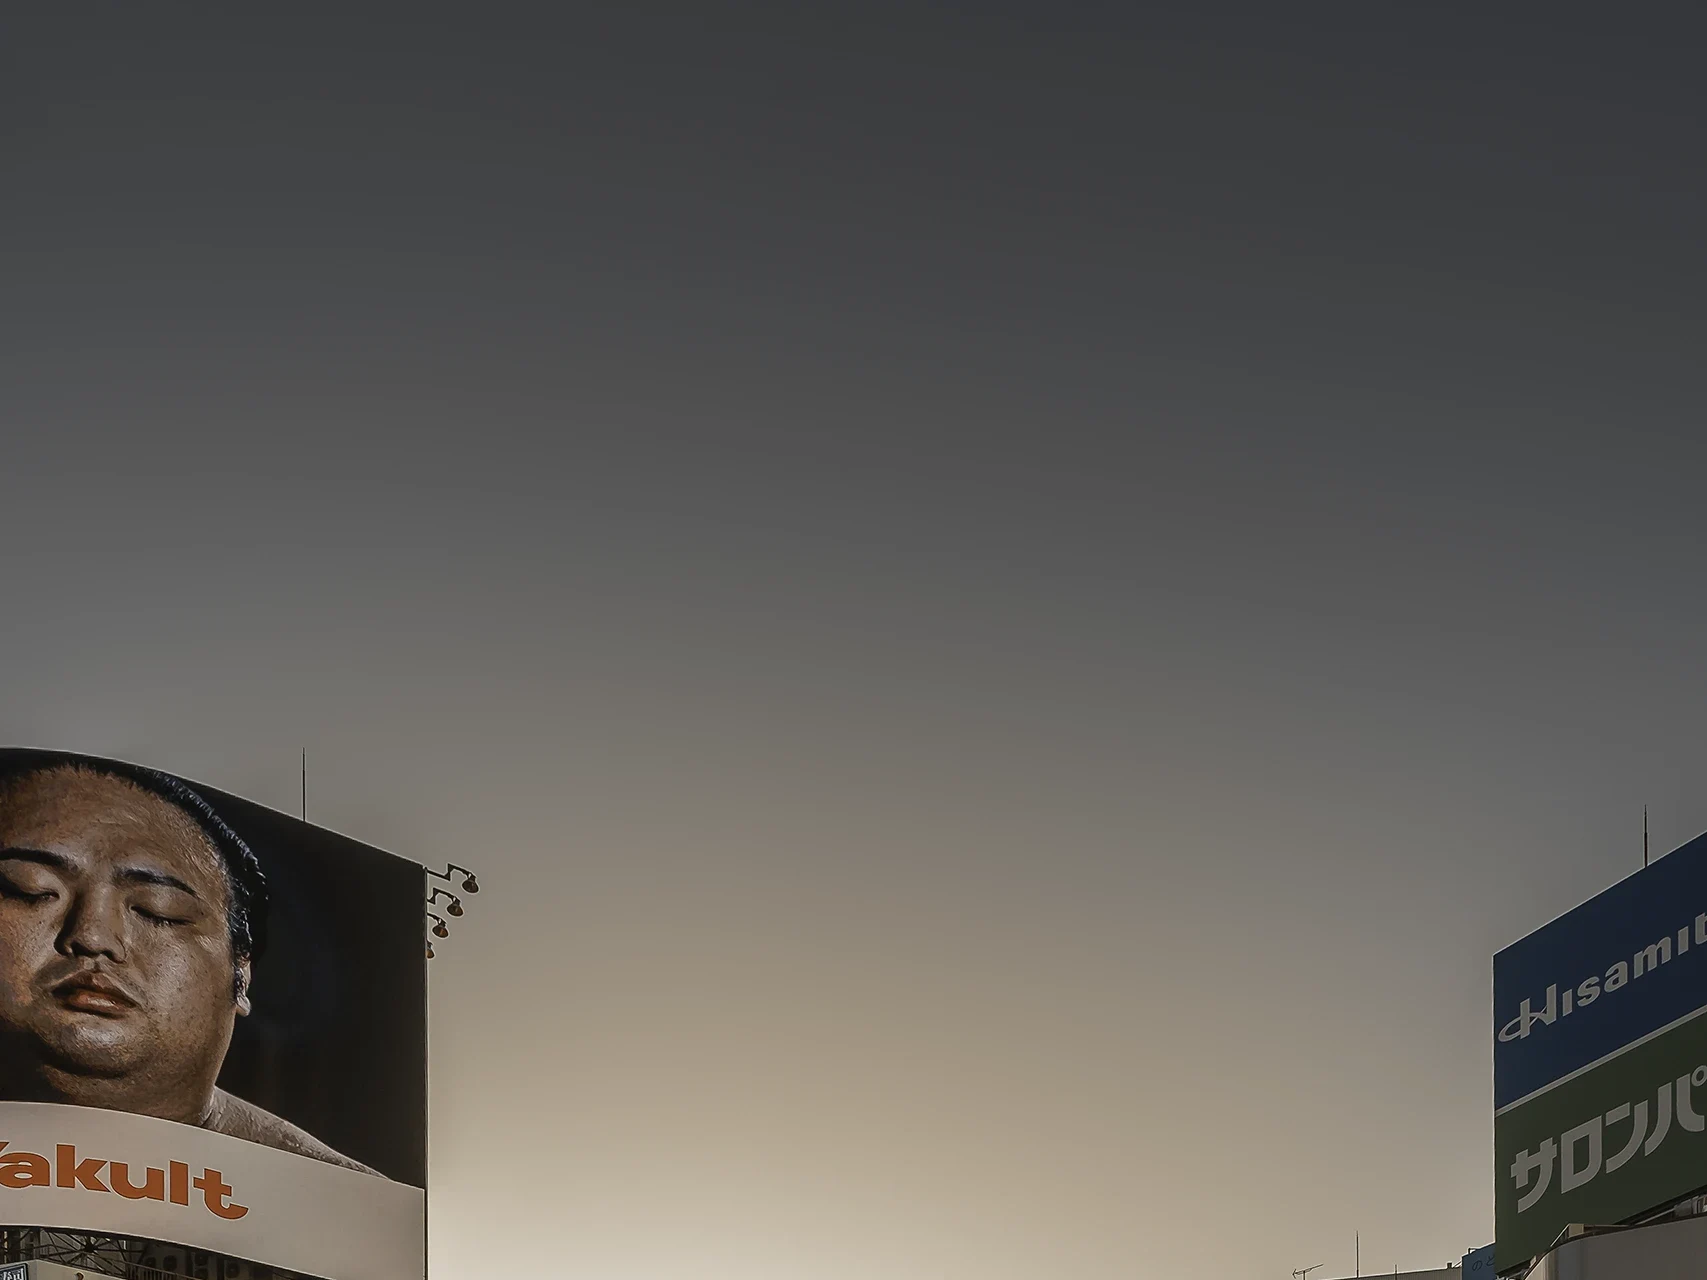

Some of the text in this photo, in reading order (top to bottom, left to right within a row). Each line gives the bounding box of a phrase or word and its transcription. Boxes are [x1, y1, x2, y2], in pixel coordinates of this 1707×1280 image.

[0, 1140, 249, 1220] akult
[1511, 1065, 1707, 1214] サロンパ
